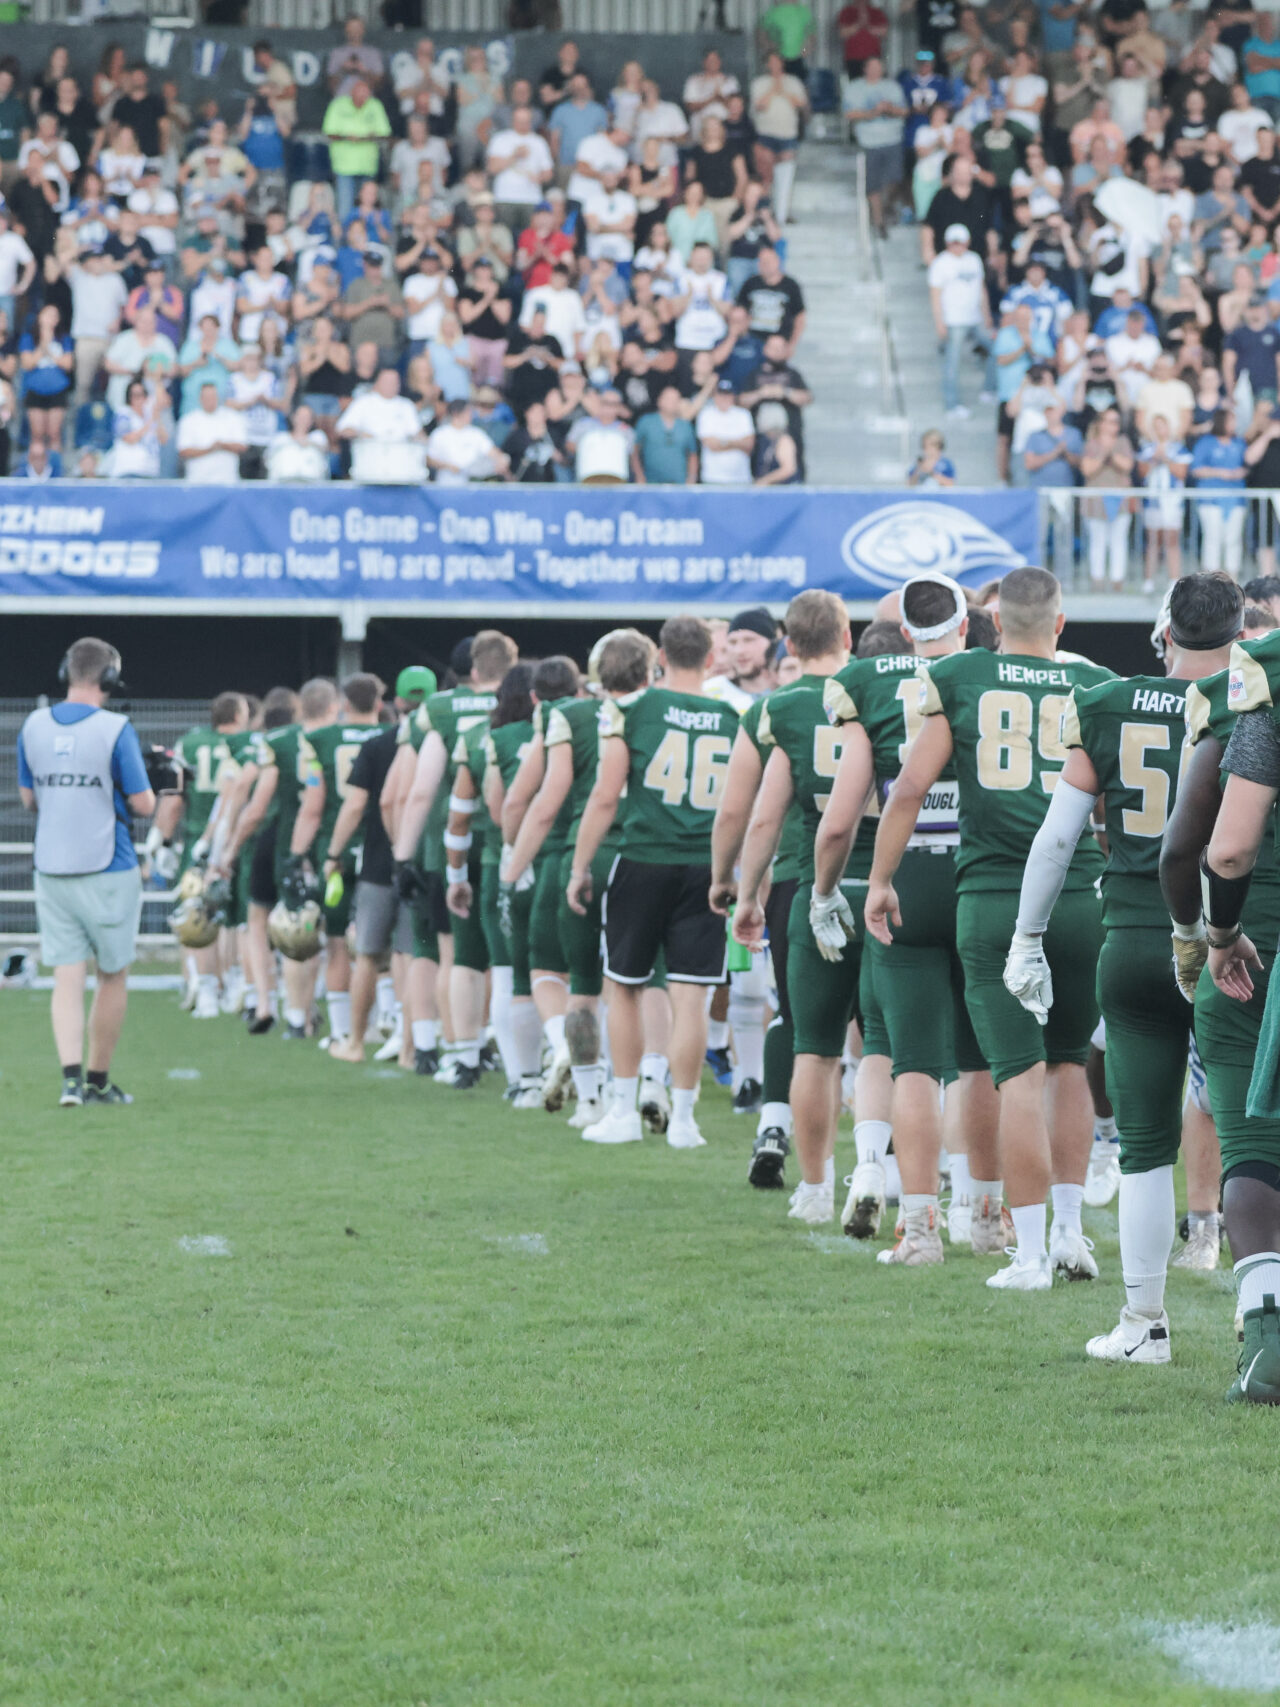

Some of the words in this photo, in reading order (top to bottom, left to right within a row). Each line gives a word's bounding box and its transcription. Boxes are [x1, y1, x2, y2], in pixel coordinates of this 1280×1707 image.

[290, 507, 341, 544] One
[345, 507, 419, 544] Game
[440, 508, 490, 545] One
[493, 510, 544, 545] Win
[565, 510, 615, 546] One
[618, 510, 704, 546] Dream
[201, 545, 239, 579] We
[242, 552, 283, 579] are
[287, 547, 340, 581] loud
[359, 547, 397, 581] We
[400, 554, 441, 581] are
[444, 549, 515, 586] proud
[534, 549, 640, 588] Together
[643, 556, 681, 583] we
[683, 556, 725, 583] are
[728, 551, 807, 588] strong
[998, 662, 1073, 687] HEMPEL
[663, 706, 723, 731] JASPERT
[977, 689, 1069, 794] 89
[643, 729, 732, 811] 46
[1118, 722, 1188, 838] 5
